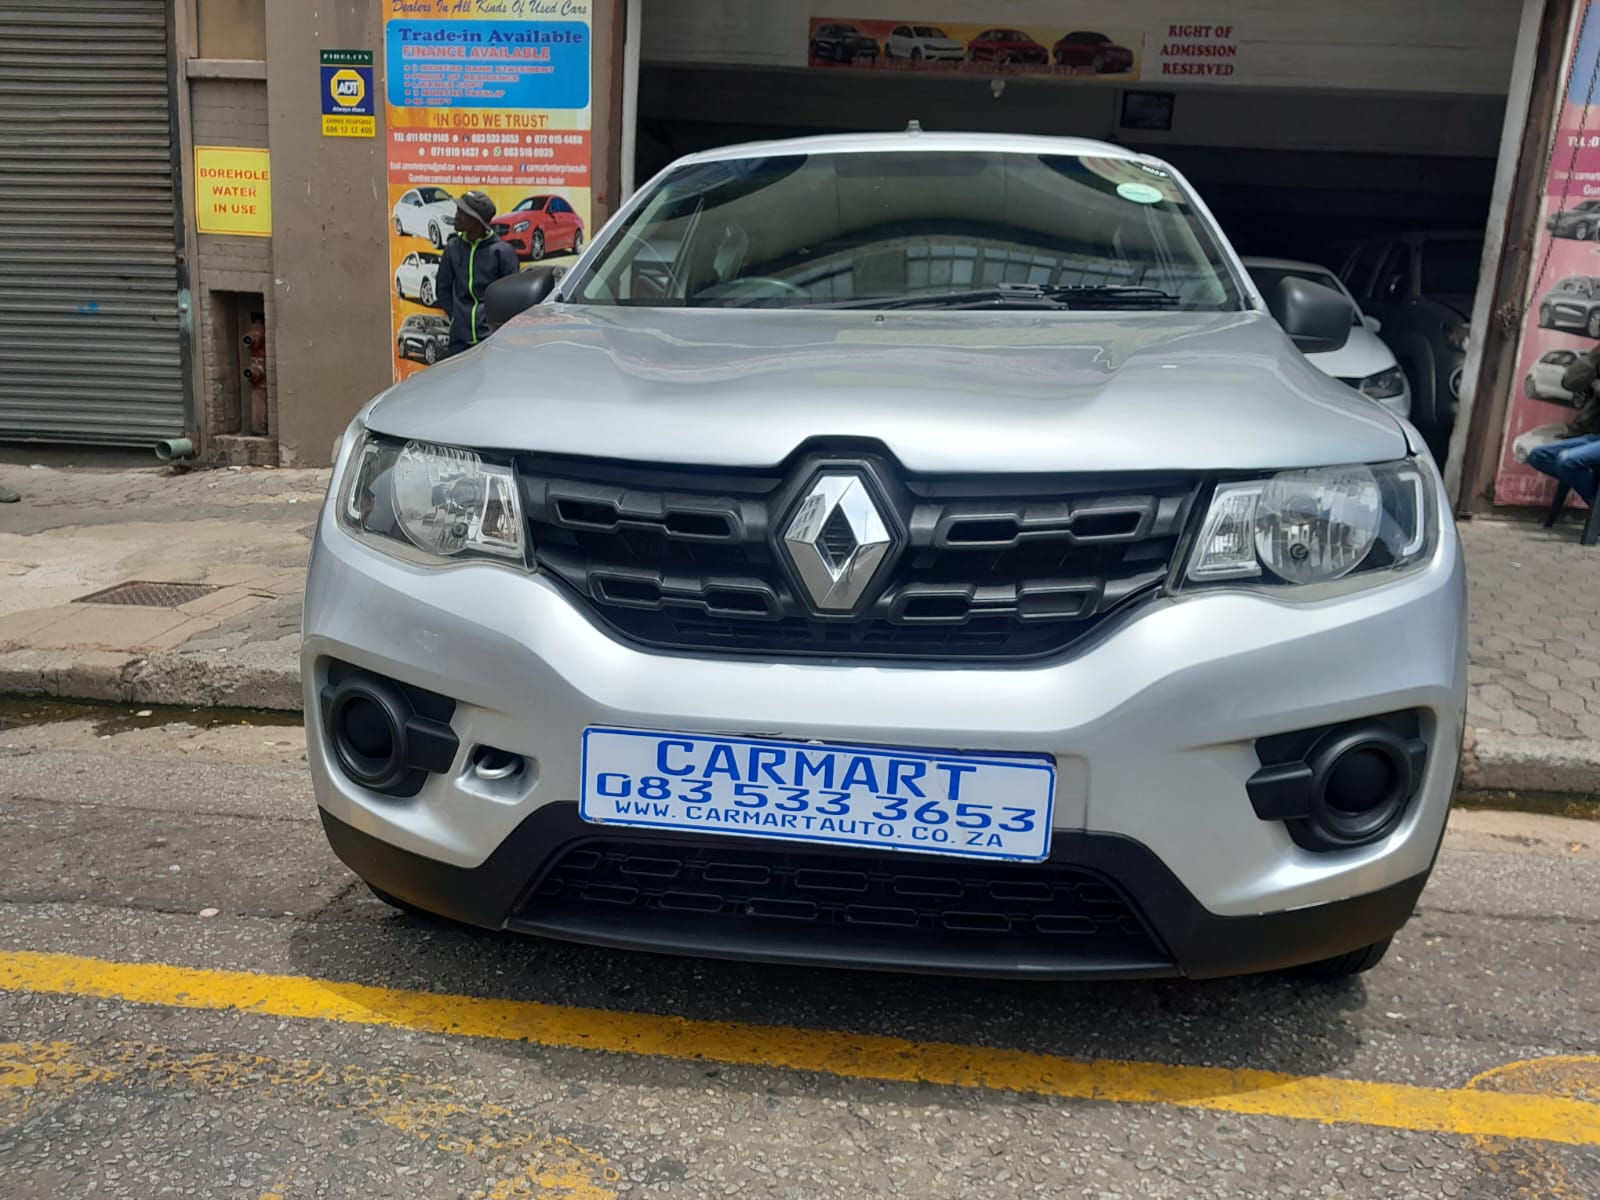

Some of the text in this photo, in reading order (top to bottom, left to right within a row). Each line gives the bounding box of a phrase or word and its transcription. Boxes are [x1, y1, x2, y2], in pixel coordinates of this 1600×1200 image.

[393, 0, 587, 17] Dealers In All Kinds Of Used Cars
[398, 28, 583, 44] Trade-in Available
[1168, 25, 1233, 38] RIGHT OF
[402, 46, 551, 59] FINANCE AVAILABLE
[1160, 44, 1237, 56] ADMISSION
[1162, 62, 1234, 76] RESERVED
[338, 81, 359, 95] ADT
[453, 114, 479, 127] GOD
[482, 114, 501, 127] WE
[200, 168, 269, 180] BOREHOLE
[212, 186, 257, 197] WATER
[214, 203, 257, 215] IN USE
[656, 740, 977, 801] CARMART
[596, 772, 1037, 833] 083 533 3653
